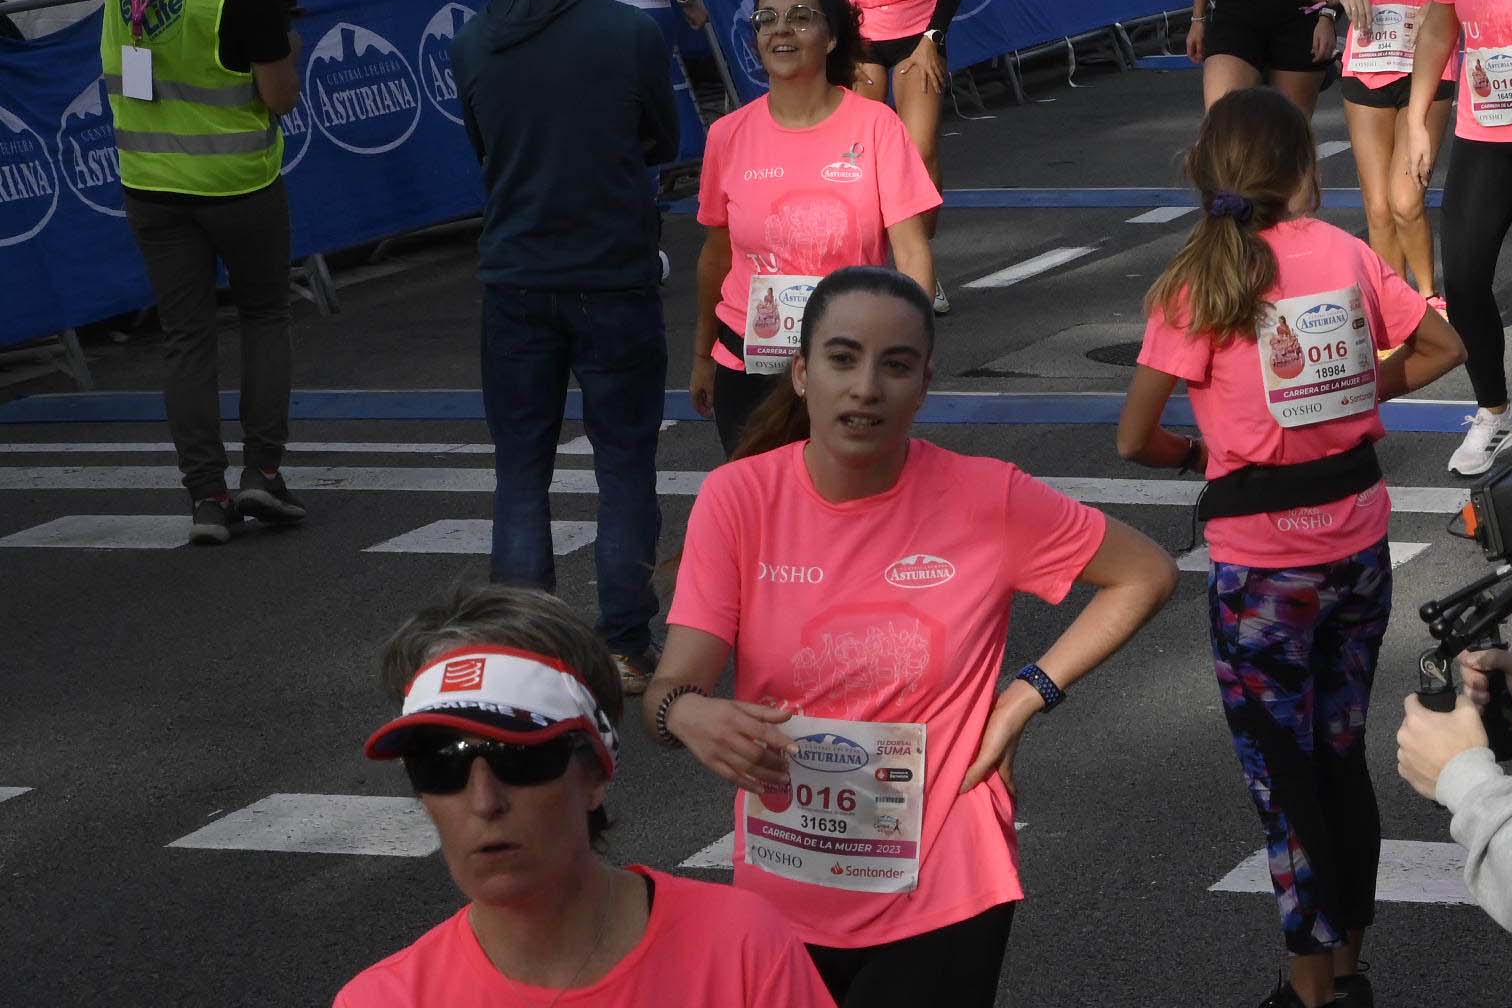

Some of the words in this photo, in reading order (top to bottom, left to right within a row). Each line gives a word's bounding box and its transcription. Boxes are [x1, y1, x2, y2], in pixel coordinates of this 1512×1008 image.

[1375, 30, 1397, 41] 016
[320, 77, 417, 129] ASTURIANA
[0, 159, 51, 203] RIANA
[743, 168, 785, 182] OYSHO
[783, 293, 808, 302] ASTUR
[1300, 314, 1345, 330] ASTURIANA
[1307, 340, 1348, 363] 016
[1315, 363, 1346, 379] 18984
[1283, 387, 1319, 398] CARRERA
[1320, 384, 1330, 392] DE
[1340, 378, 1360, 388] MUJER
[1282, 402, 1323, 418] OYSHO
[1277, 512, 1333, 532] OYSHO
[890, 564, 952, 582] ASTURIANA
[876, 745, 912, 756] SUMA
[796, 783, 857, 812] 016
[800, 814, 847, 834] 31639
[762, 825, 803, 843] CARRERA
[804, 837, 816, 848] DE
[819, 839, 832, 849] LA
[834, 841, 872, 853] MUJER
[876, 844, 901, 854] 2023
[757, 846, 803, 869] OYSHO
[845, 865, 905, 879] Santander
